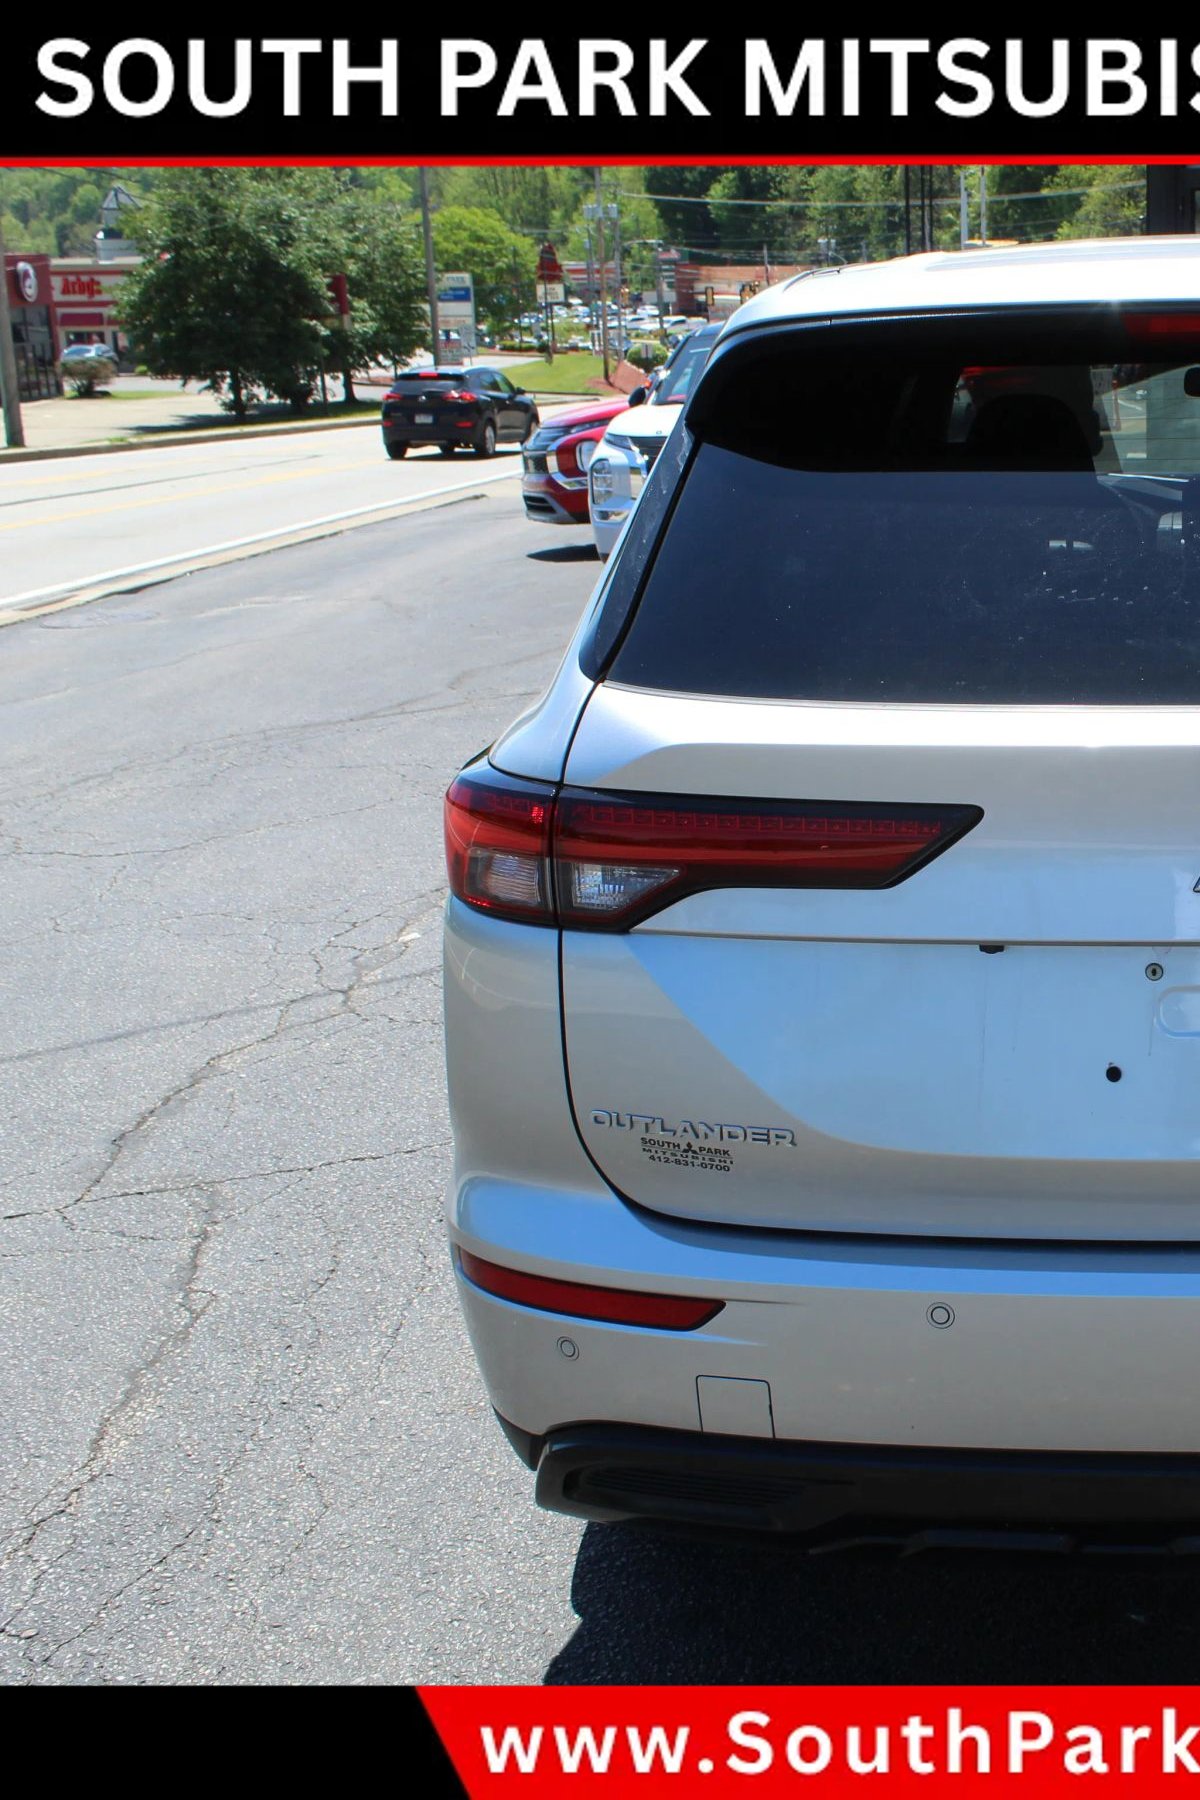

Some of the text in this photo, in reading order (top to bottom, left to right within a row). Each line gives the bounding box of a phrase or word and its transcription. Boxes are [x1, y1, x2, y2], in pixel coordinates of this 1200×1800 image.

[591, 1109, 797, 1147] OUTLANDER
[640, 1137, 731, 1157] SOUTH PARK
[642, 1147, 734, 1165] MITSUBISHI
[648, 1155, 731, 1172] 412-831-0700
